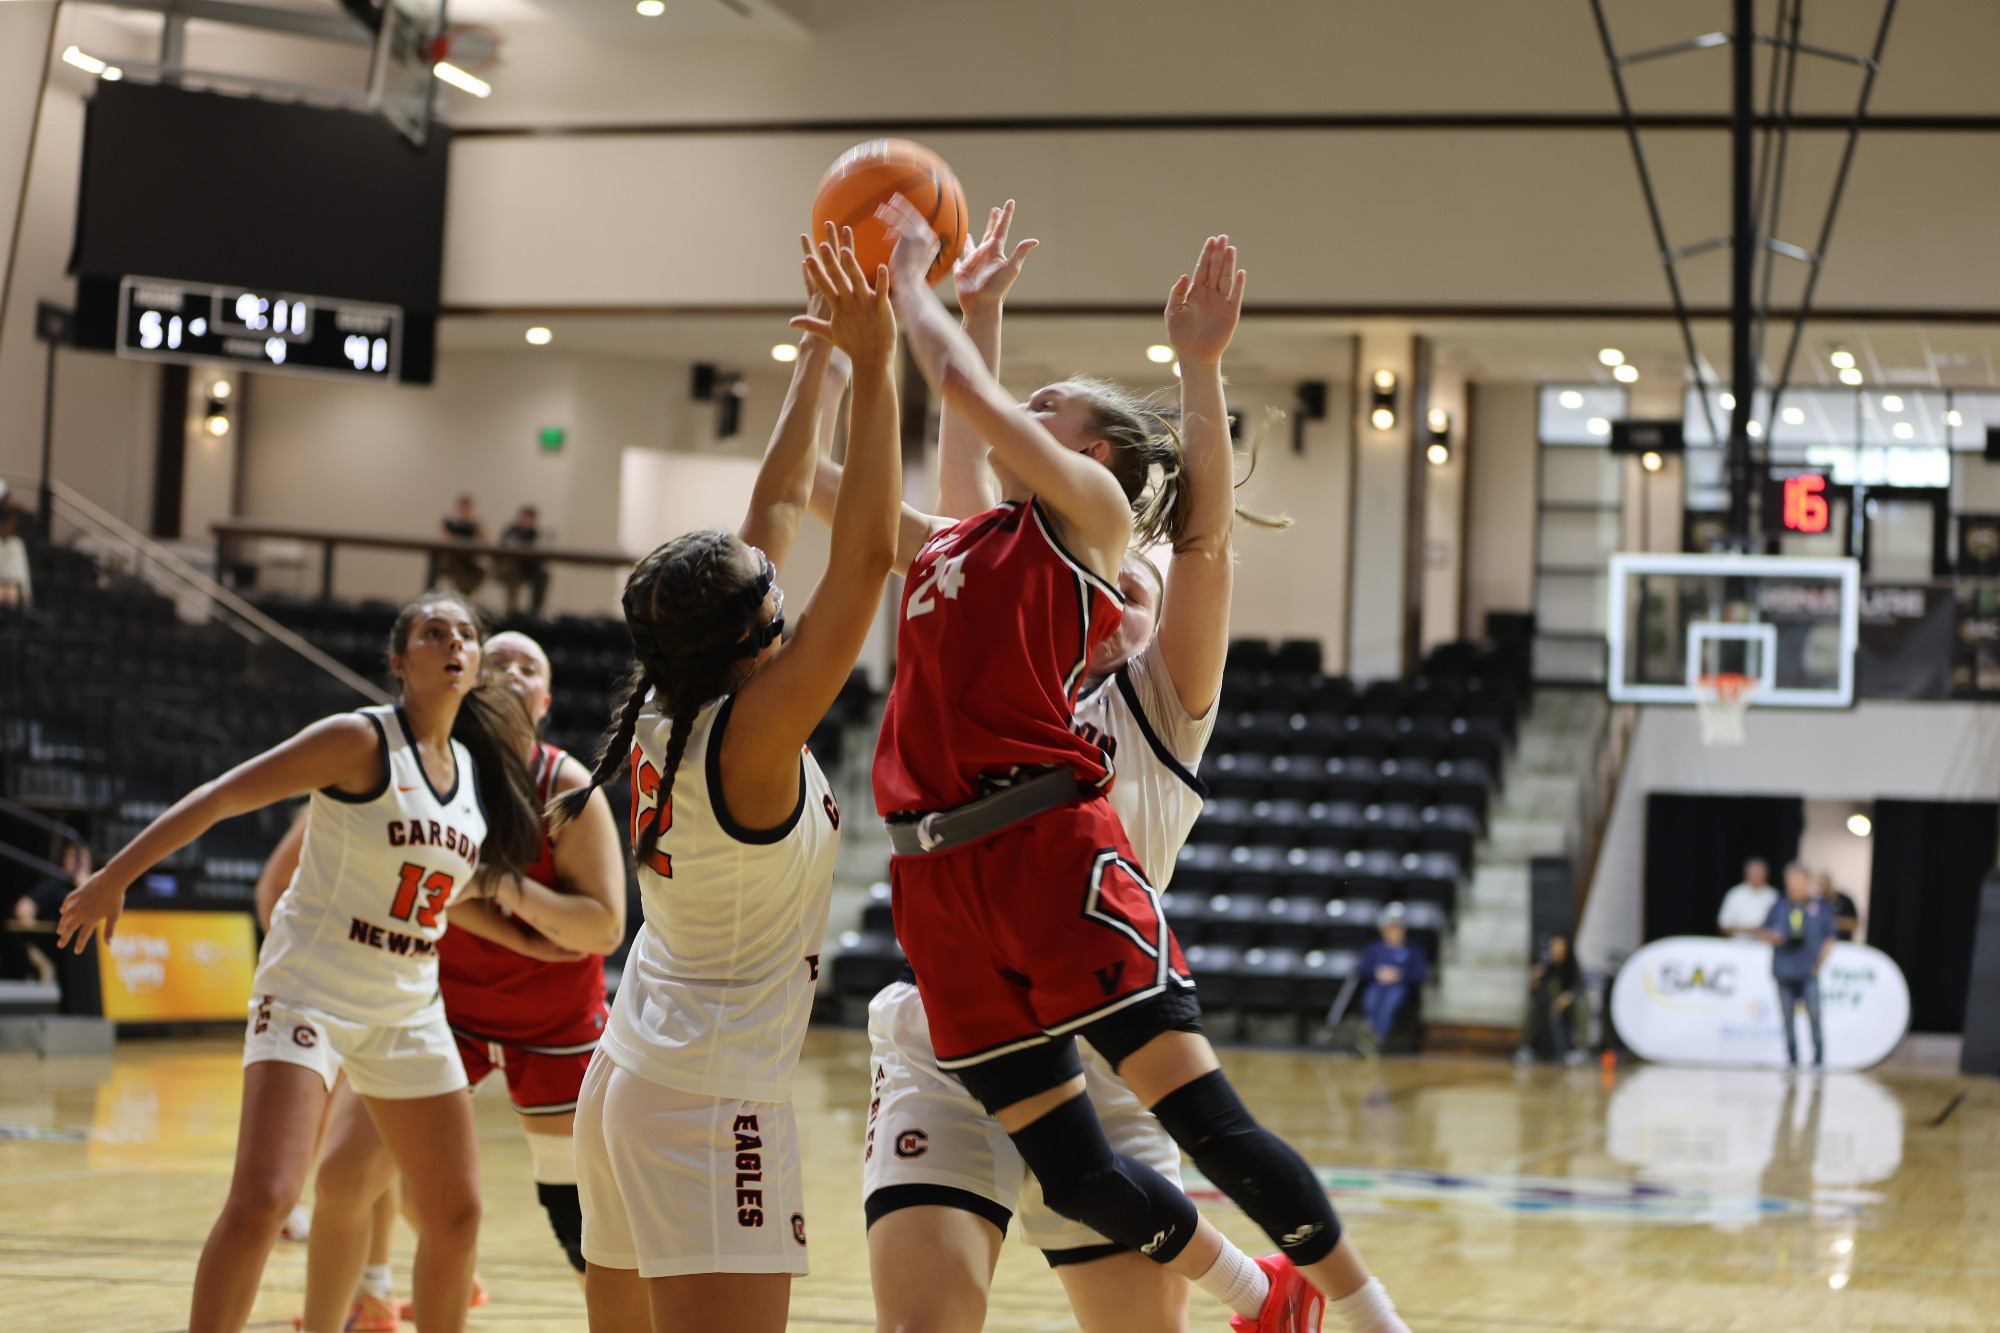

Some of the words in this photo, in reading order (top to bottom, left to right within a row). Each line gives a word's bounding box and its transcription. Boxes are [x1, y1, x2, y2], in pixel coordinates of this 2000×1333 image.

[139, 311, 183, 349] 51
[1784, 474, 1828, 533] 16
[906, 550, 966, 621] 24
[389, 860, 454, 928] 13
[1093, 960, 1126, 997] V
[732, 1114, 764, 1228] EAGLES
